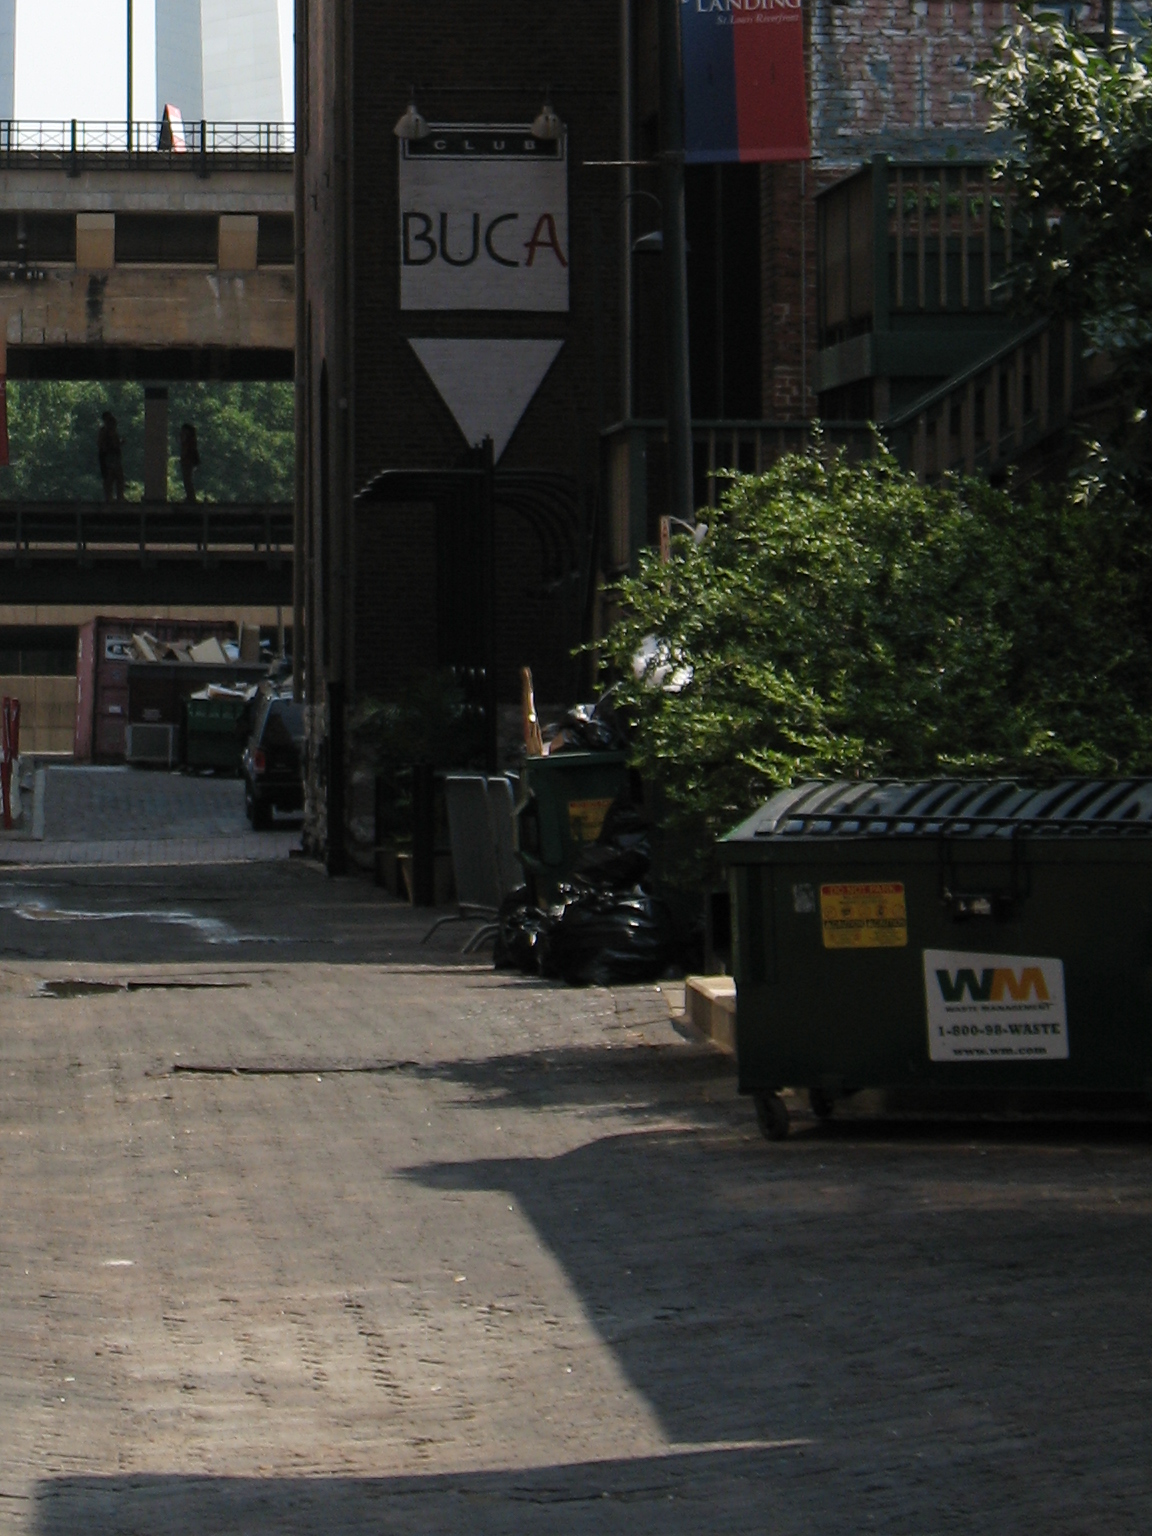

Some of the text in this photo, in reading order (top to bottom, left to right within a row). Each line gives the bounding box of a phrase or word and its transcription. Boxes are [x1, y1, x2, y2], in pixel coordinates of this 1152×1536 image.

[433, 139, 537, 151] CLUB
[402, 212, 568, 267] BUCA
[935, 966, 1051, 1002] WM
[938, 1022, 1061, 1037] 1-800-98-WASTE
[952, 1046, 1048, 1056] www.wm.com
